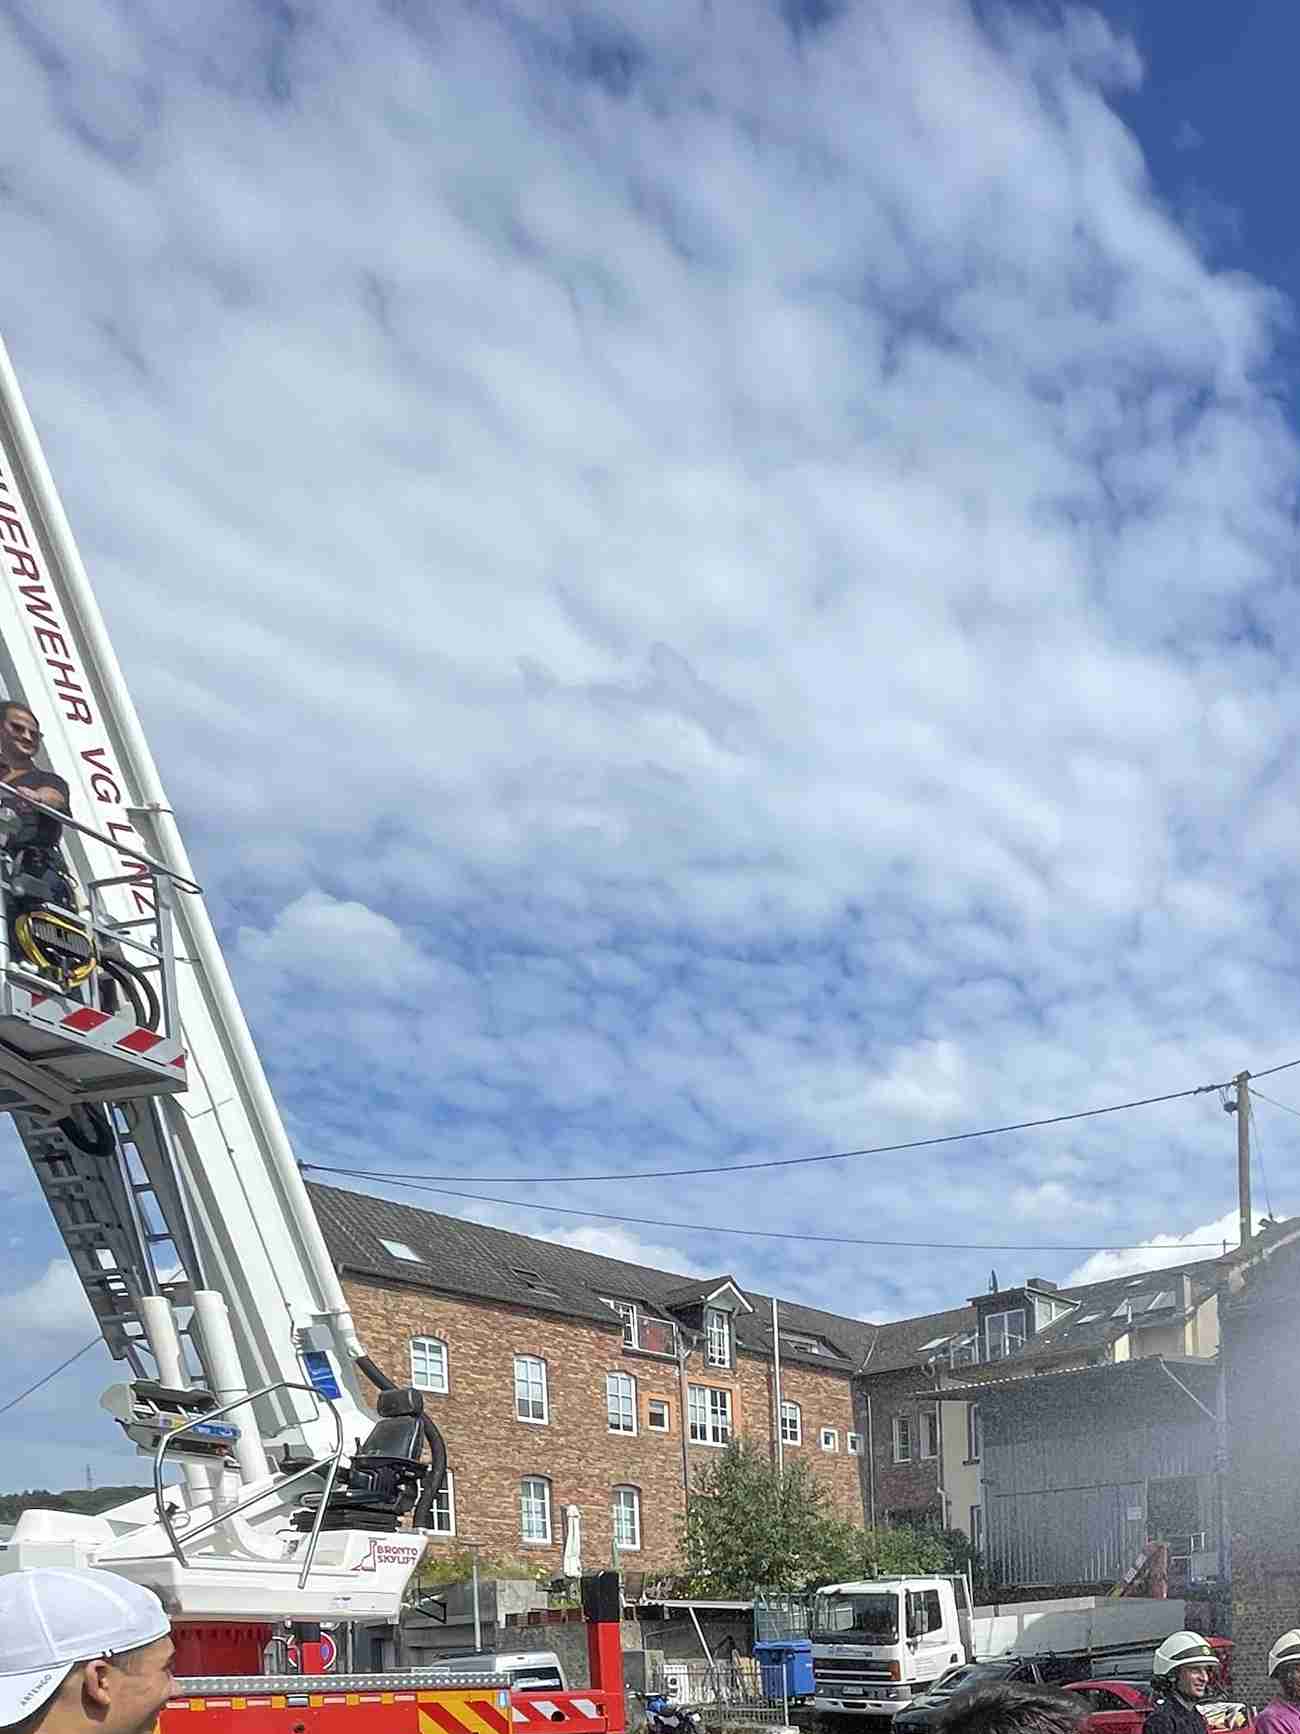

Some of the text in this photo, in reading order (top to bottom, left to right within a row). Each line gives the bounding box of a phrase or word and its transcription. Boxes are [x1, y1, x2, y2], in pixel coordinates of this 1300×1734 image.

[79, 747, 122, 805] VG
[376, 1545, 418, 1556] BRONTO
[376, 1555, 417, 1566] SKYLIFT
